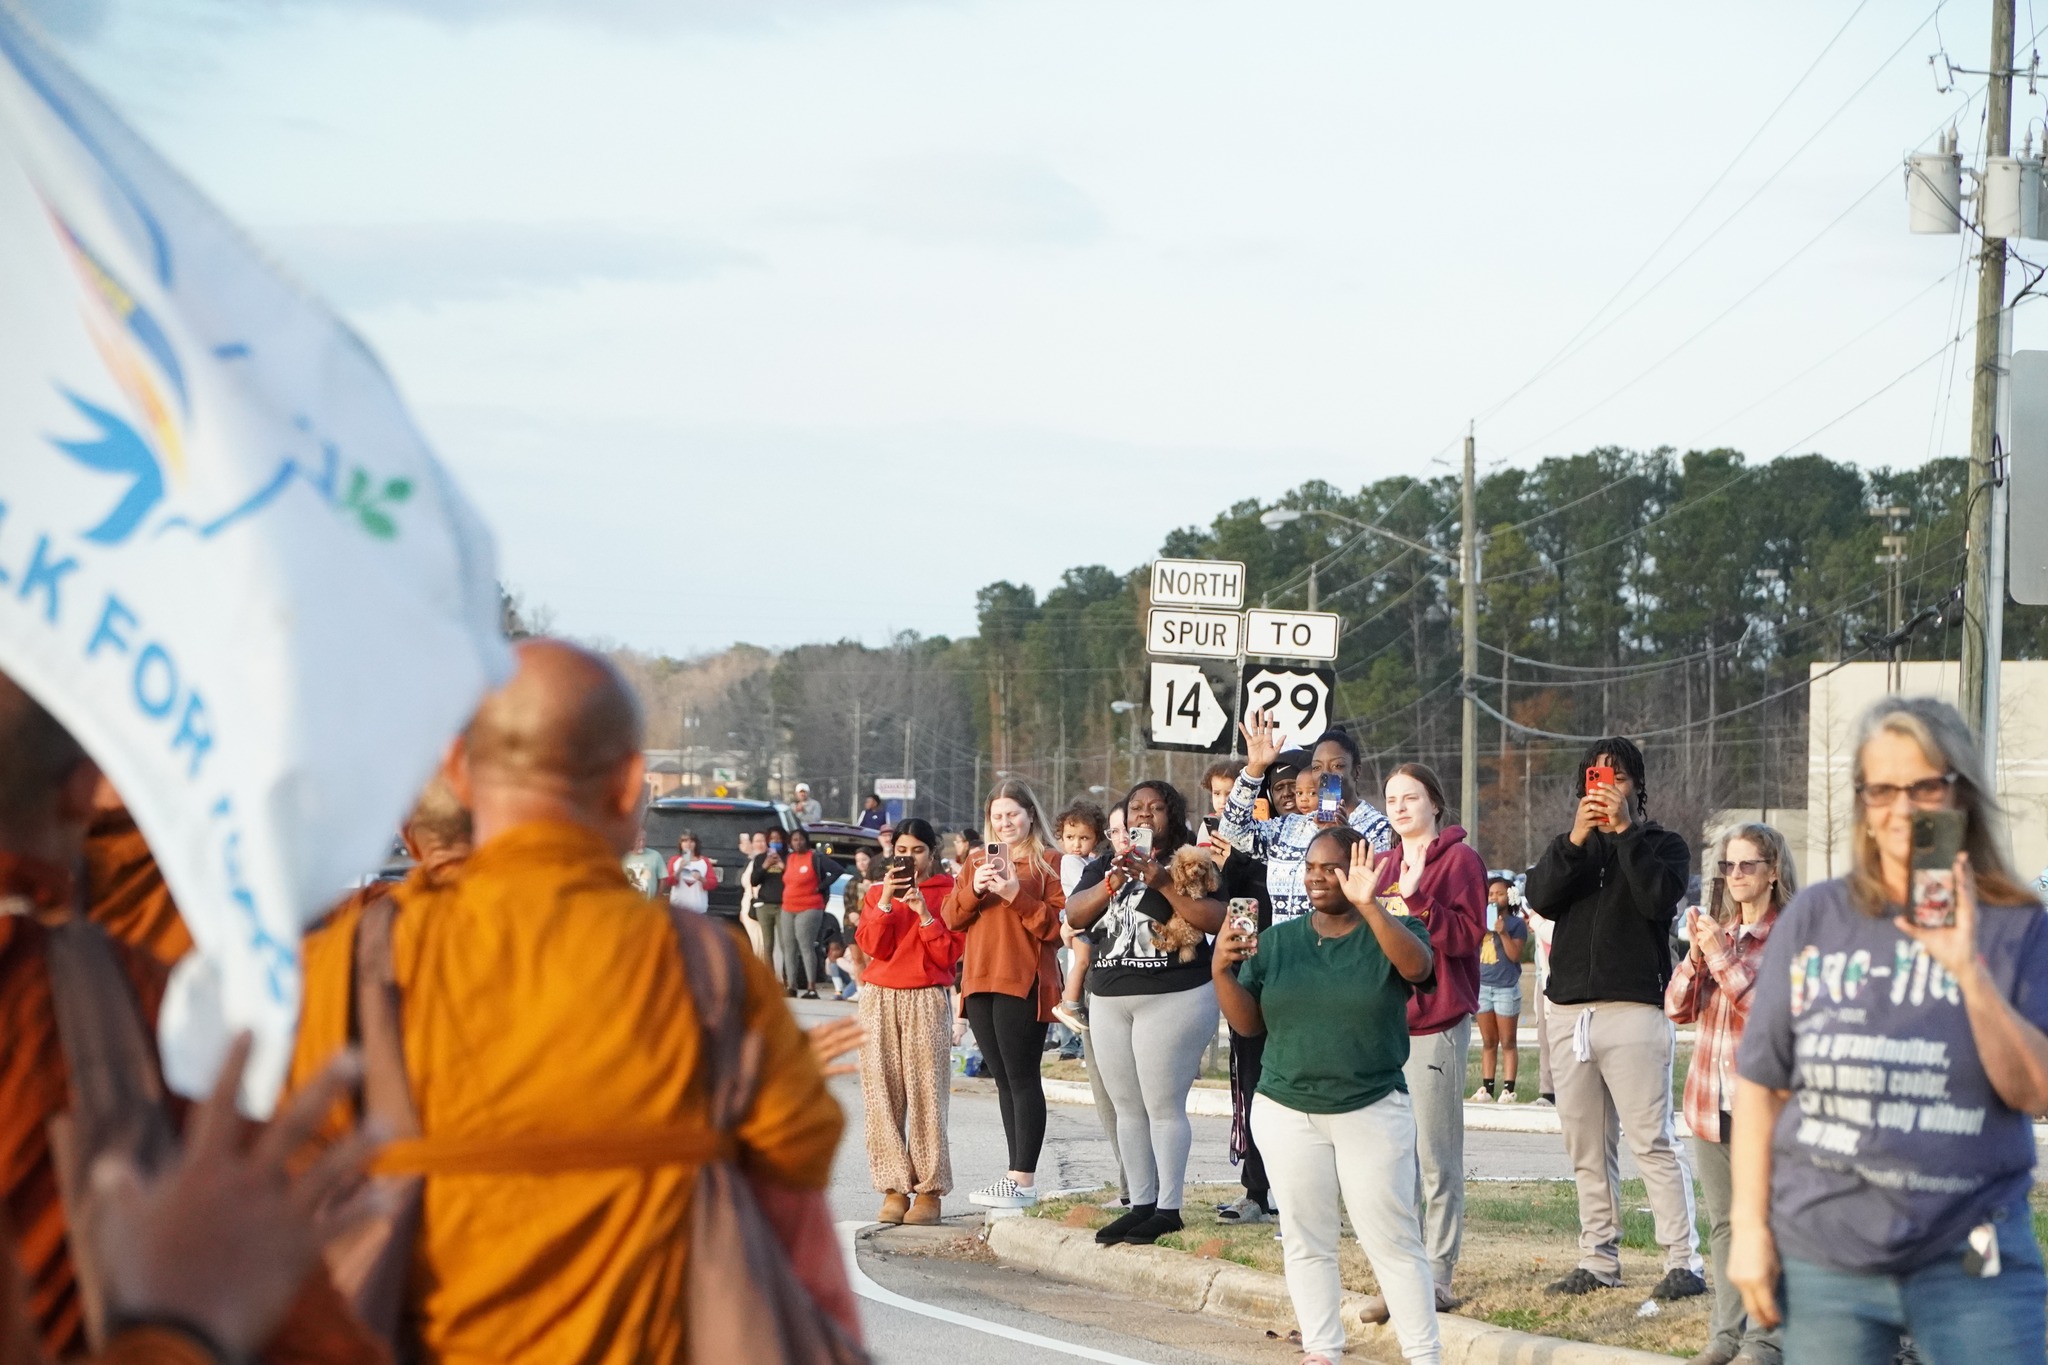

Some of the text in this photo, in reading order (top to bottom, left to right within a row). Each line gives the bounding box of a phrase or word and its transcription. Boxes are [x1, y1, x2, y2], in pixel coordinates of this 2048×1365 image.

[1159, 568, 1237, 598] NORTH
[1162, 620, 1227, 647] SPUR
[1271, 622, 1312, 647] TO
[86, 594, 213, 780] FOR
[1165, 679, 1201, 729] 14
[1253, 680, 1319, 731] 29
